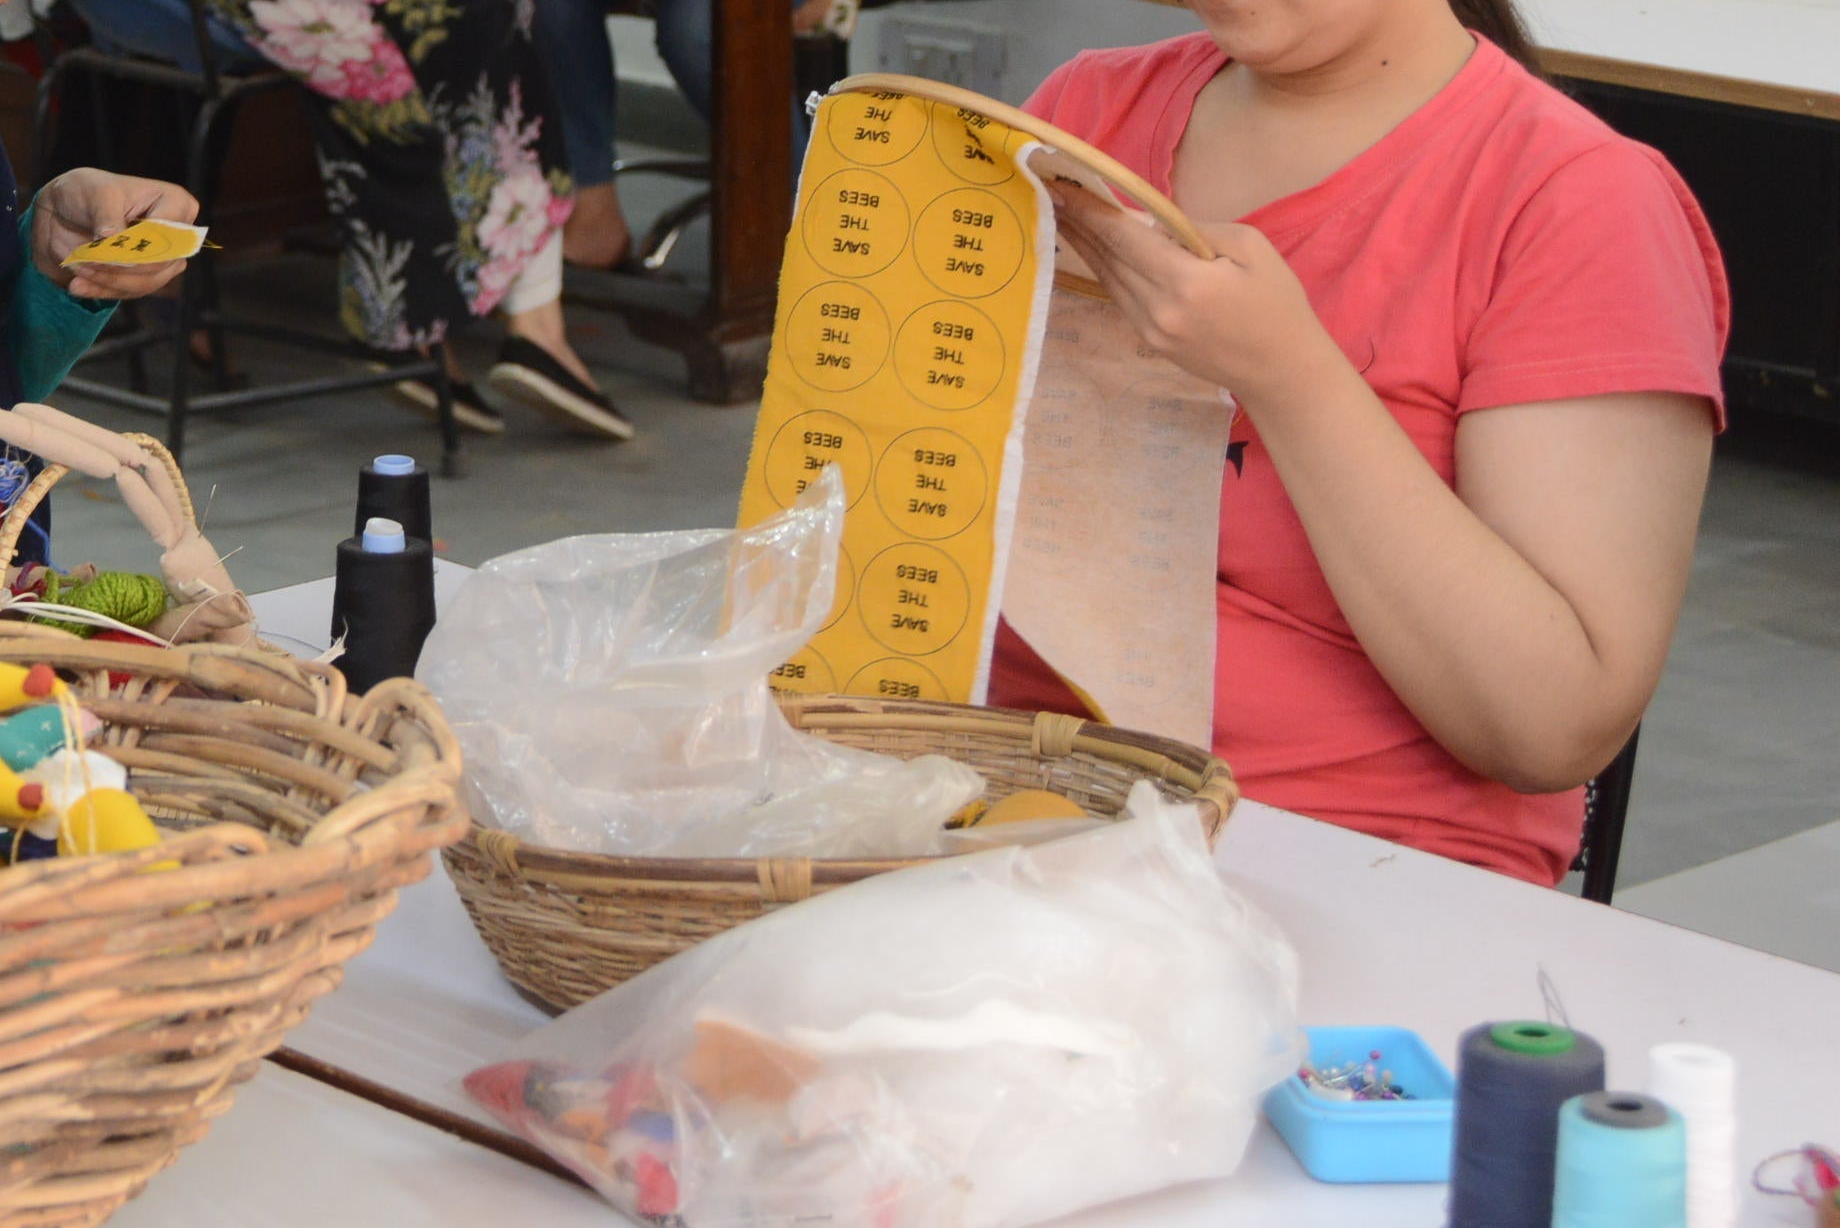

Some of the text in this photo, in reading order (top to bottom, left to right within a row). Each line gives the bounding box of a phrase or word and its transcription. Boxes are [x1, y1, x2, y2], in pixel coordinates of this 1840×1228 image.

[854, 127, 890, 144] SAVE
[838, 189, 880, 208] BEES
[839, 214, 871, 231] THE
[952, 208, 994, 229] BEES
[833, 237, 870, 256] SAVE
[954, 234, 985, 252] THE
[945, 257, 985, 277] SAVE
[820, 303, 861, 321] BEES
[821, 328, 852, 345] THE
[933, 321, 974, 341] BEES
[815, 352, 851, 370] SAVE
[934, 346, 965, 365] THE
[927, 370, 965, 389] SAVE
[803, 431, 843, 449] BEES
[803, 456, 832, 471] HE
[914, 449, 958, 468] BEES
[916, 474, 948, 492] THE
[908, 499, 947, 518] SAVE
[896, 564, 938, 584] BEES
[898, 589, 929, 608] THE
[891, 613, 928, 633] SAVE
[879, 679, 920, 698] BEES
